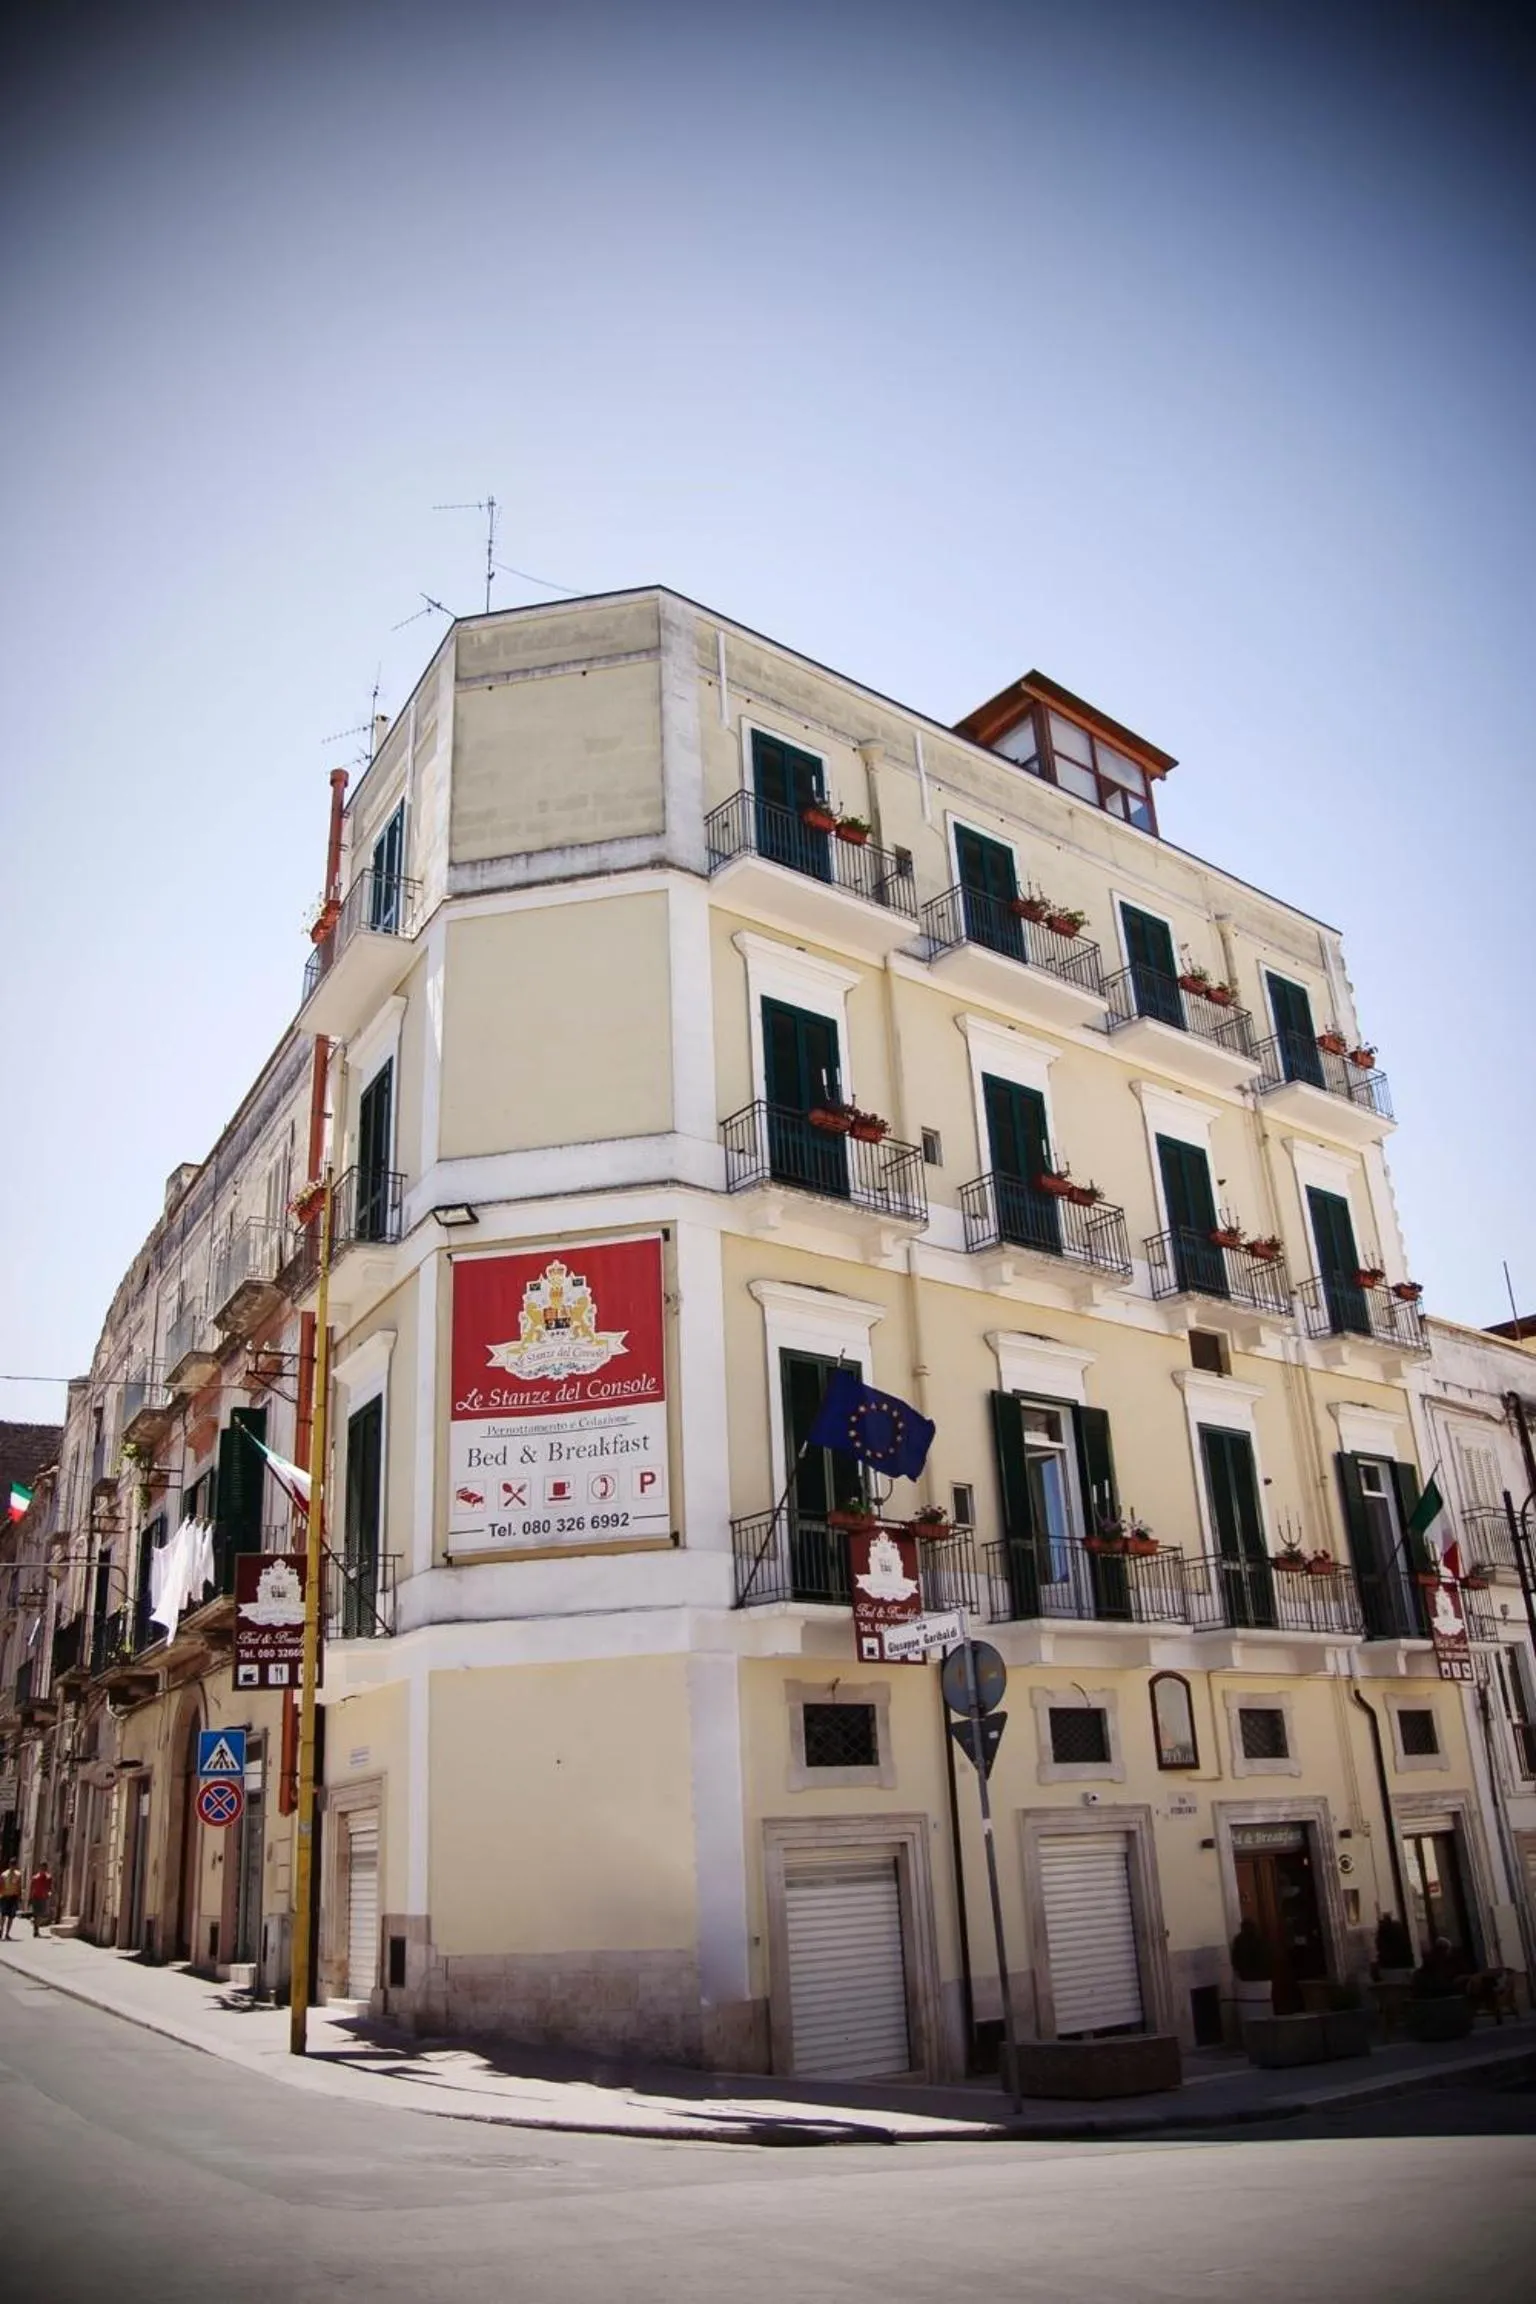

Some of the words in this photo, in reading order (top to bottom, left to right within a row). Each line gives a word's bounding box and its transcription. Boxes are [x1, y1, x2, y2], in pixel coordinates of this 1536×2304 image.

[556, 1345, 571, 1357] del
[456, 1387, 483, 1411] Le
[488, 1387, 550, 1408] Stanze
[555, 1382, 580, 1402] del
[586, 1373, 657, 1399] Console
[487, 1419, 568, 1436] Pernottamento
[578, 1413, 630, 1428] Colazione
[468, 1445, 508, 1468] Bed
[520, 1444, 537, 1464] &
[548, 1433, 650, 1462] Breakfast
[639, 1471, 656, 1494] P
[489, 1522, 517, 1538] Tel.
[522, 1520, 551, 1536] 080
[556, 1516, 585, 1532] 326
[590, 1512, 630, 1530] 6992
[924, 1626, 958, 1644] Garibaldi
